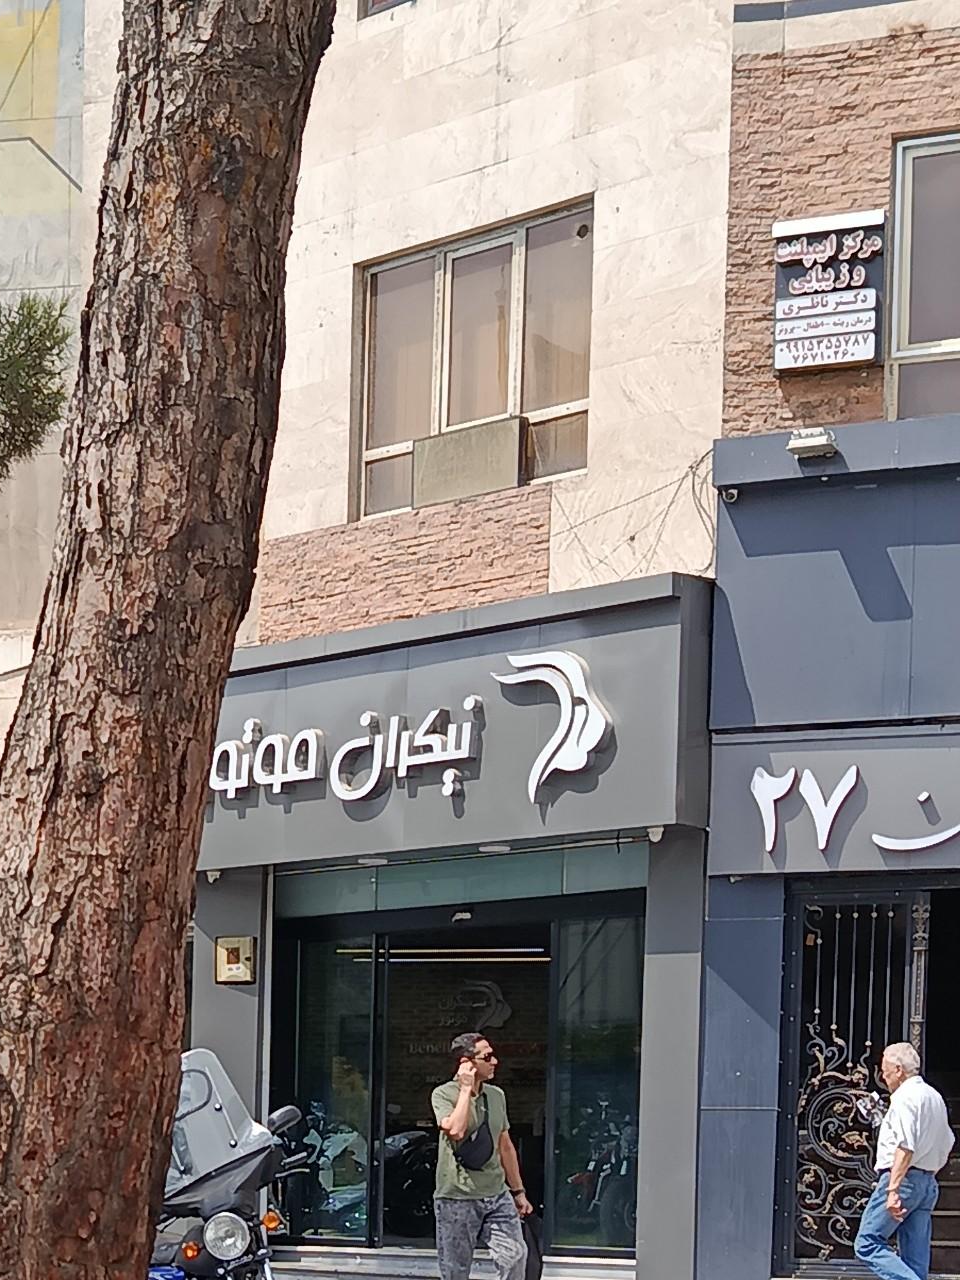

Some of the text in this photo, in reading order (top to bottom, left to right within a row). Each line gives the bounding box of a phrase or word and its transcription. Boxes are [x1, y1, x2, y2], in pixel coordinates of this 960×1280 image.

[774, 229, 882, 268] مرکز ایمپلنت
[788, 261, 866, 294] و زیبایی
[782, 292, 868, 316] دکتر ناظری
[208, 694, 483, 801] نیکران موتو
[750, 764, 860, 853] ۲۷
